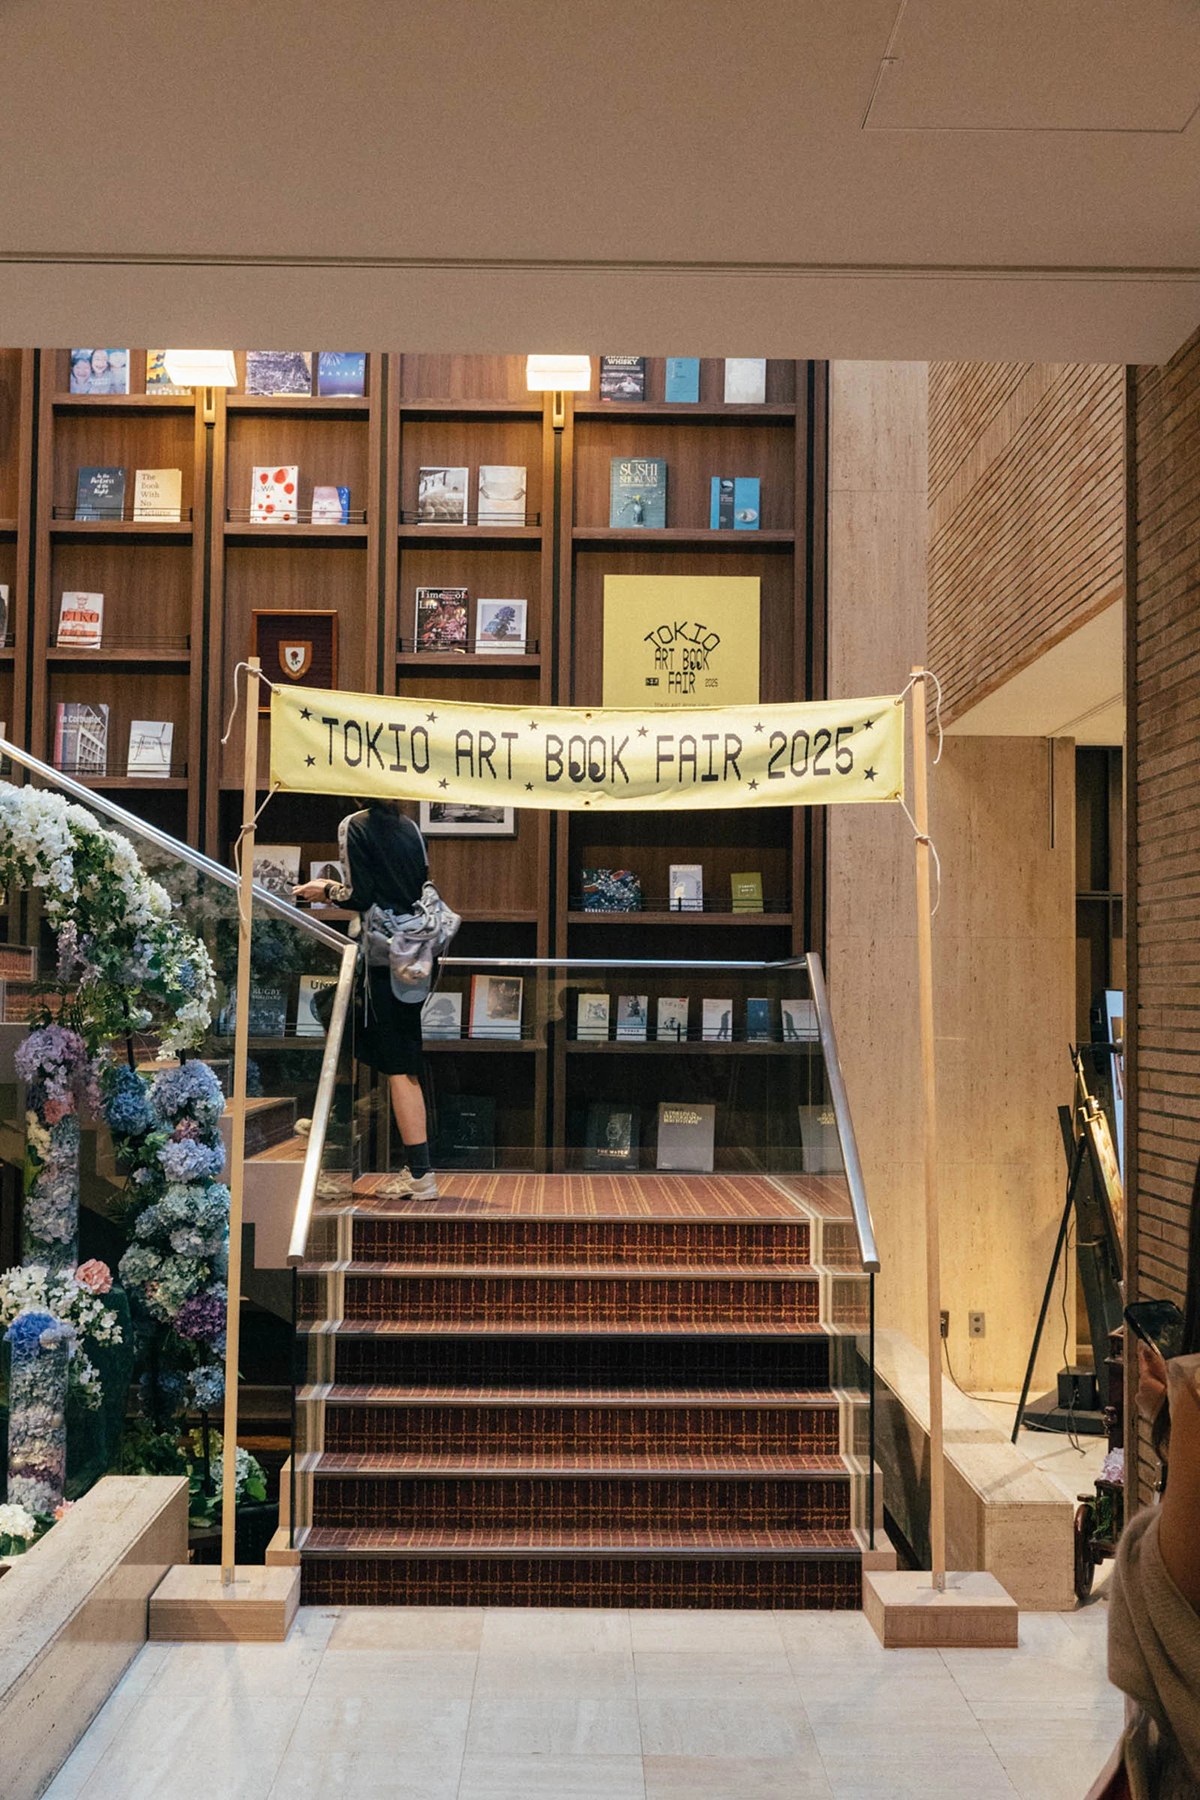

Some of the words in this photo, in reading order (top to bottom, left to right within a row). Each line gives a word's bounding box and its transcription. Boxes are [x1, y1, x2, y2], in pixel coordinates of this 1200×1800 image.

[619, 463, 658, 476] SUSHI
[420, 590, 443, 599] Time
[455, 590, 465, 599] of
[419, 600, 438, 609] Life
[62, 611, 99, 623] EIKO
[644, 621, 720, 651] TOKIO
[654, 647, 675, 670] ART
[682, 647, 710, 671] BOOK
[668, 671, 696, 694] FAIR
[705, 678, 718, 688] 2025
[59, 715, 67, 723] Le
[322, 716, 430, 774] TOKIO
[456, 729, 519, 780] ART
[546, 734, 630, 783] BOOK
[656, 733, 743, 783] FAIR
[768, 726, 854, 779] 2025
[252, 988, 282, 996] RUGBY
